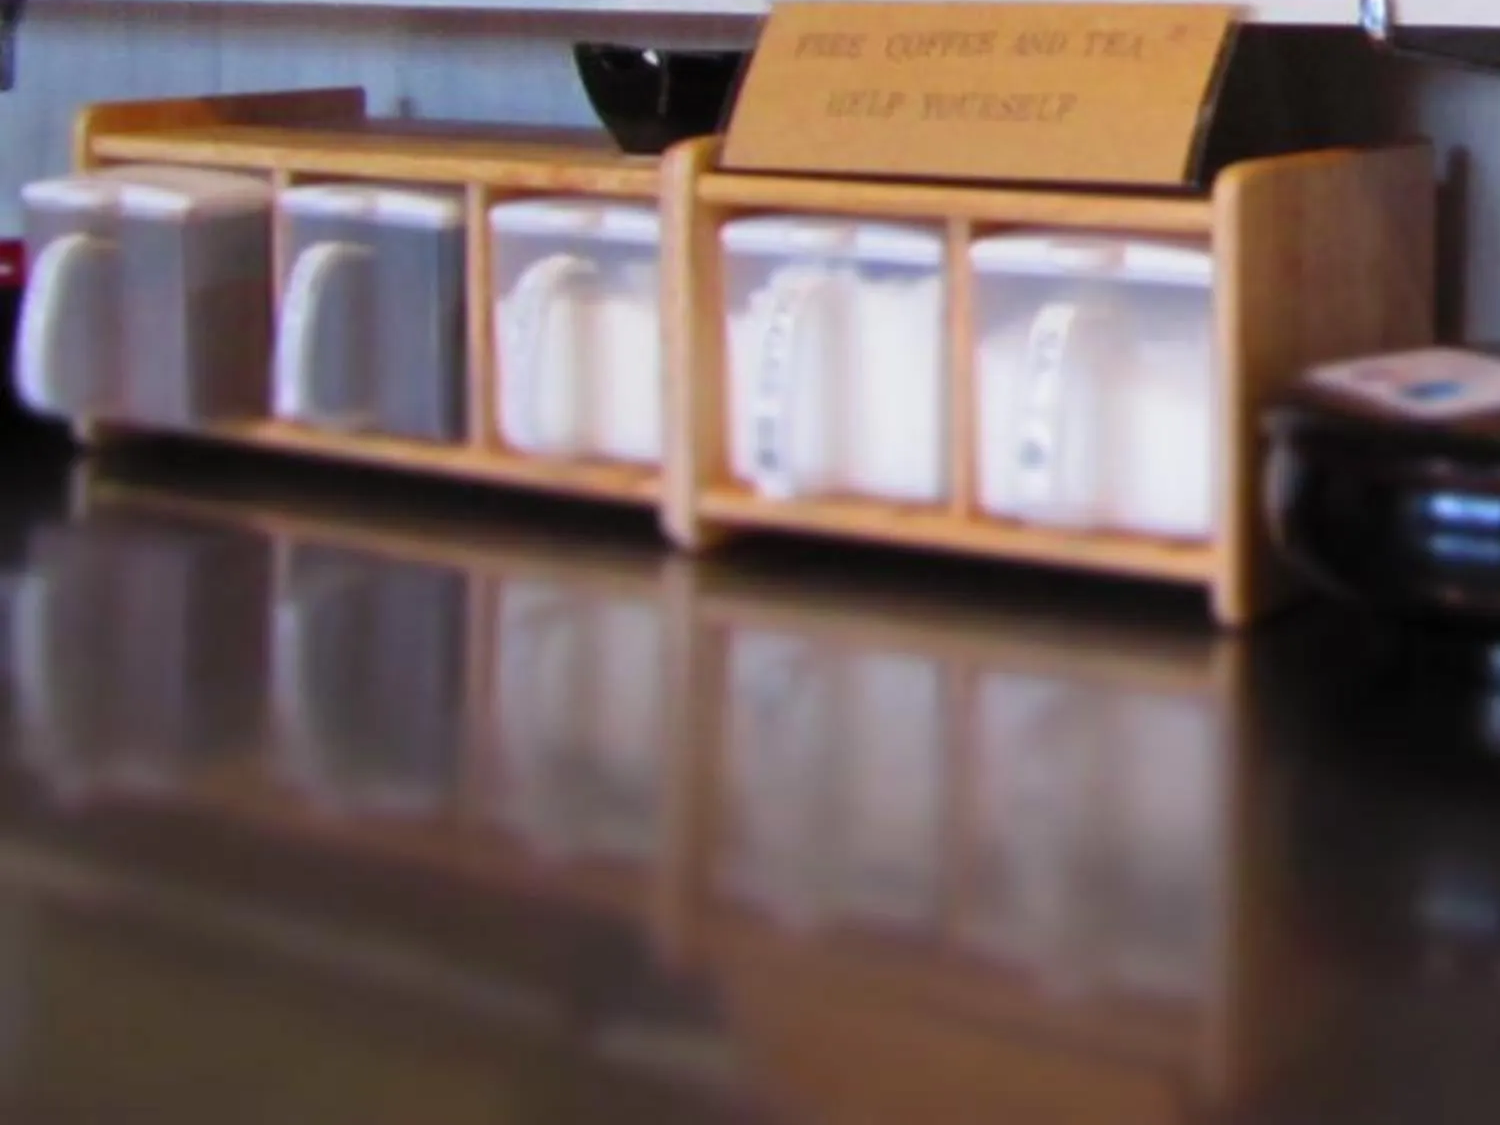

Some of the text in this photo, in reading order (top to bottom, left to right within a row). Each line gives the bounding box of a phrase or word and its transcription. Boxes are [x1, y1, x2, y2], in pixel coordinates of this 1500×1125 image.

[794, 29, 1145, 62] FREE COFFEE AND TEA
[826, 90, 1078, 121] HELP YOURSELF
